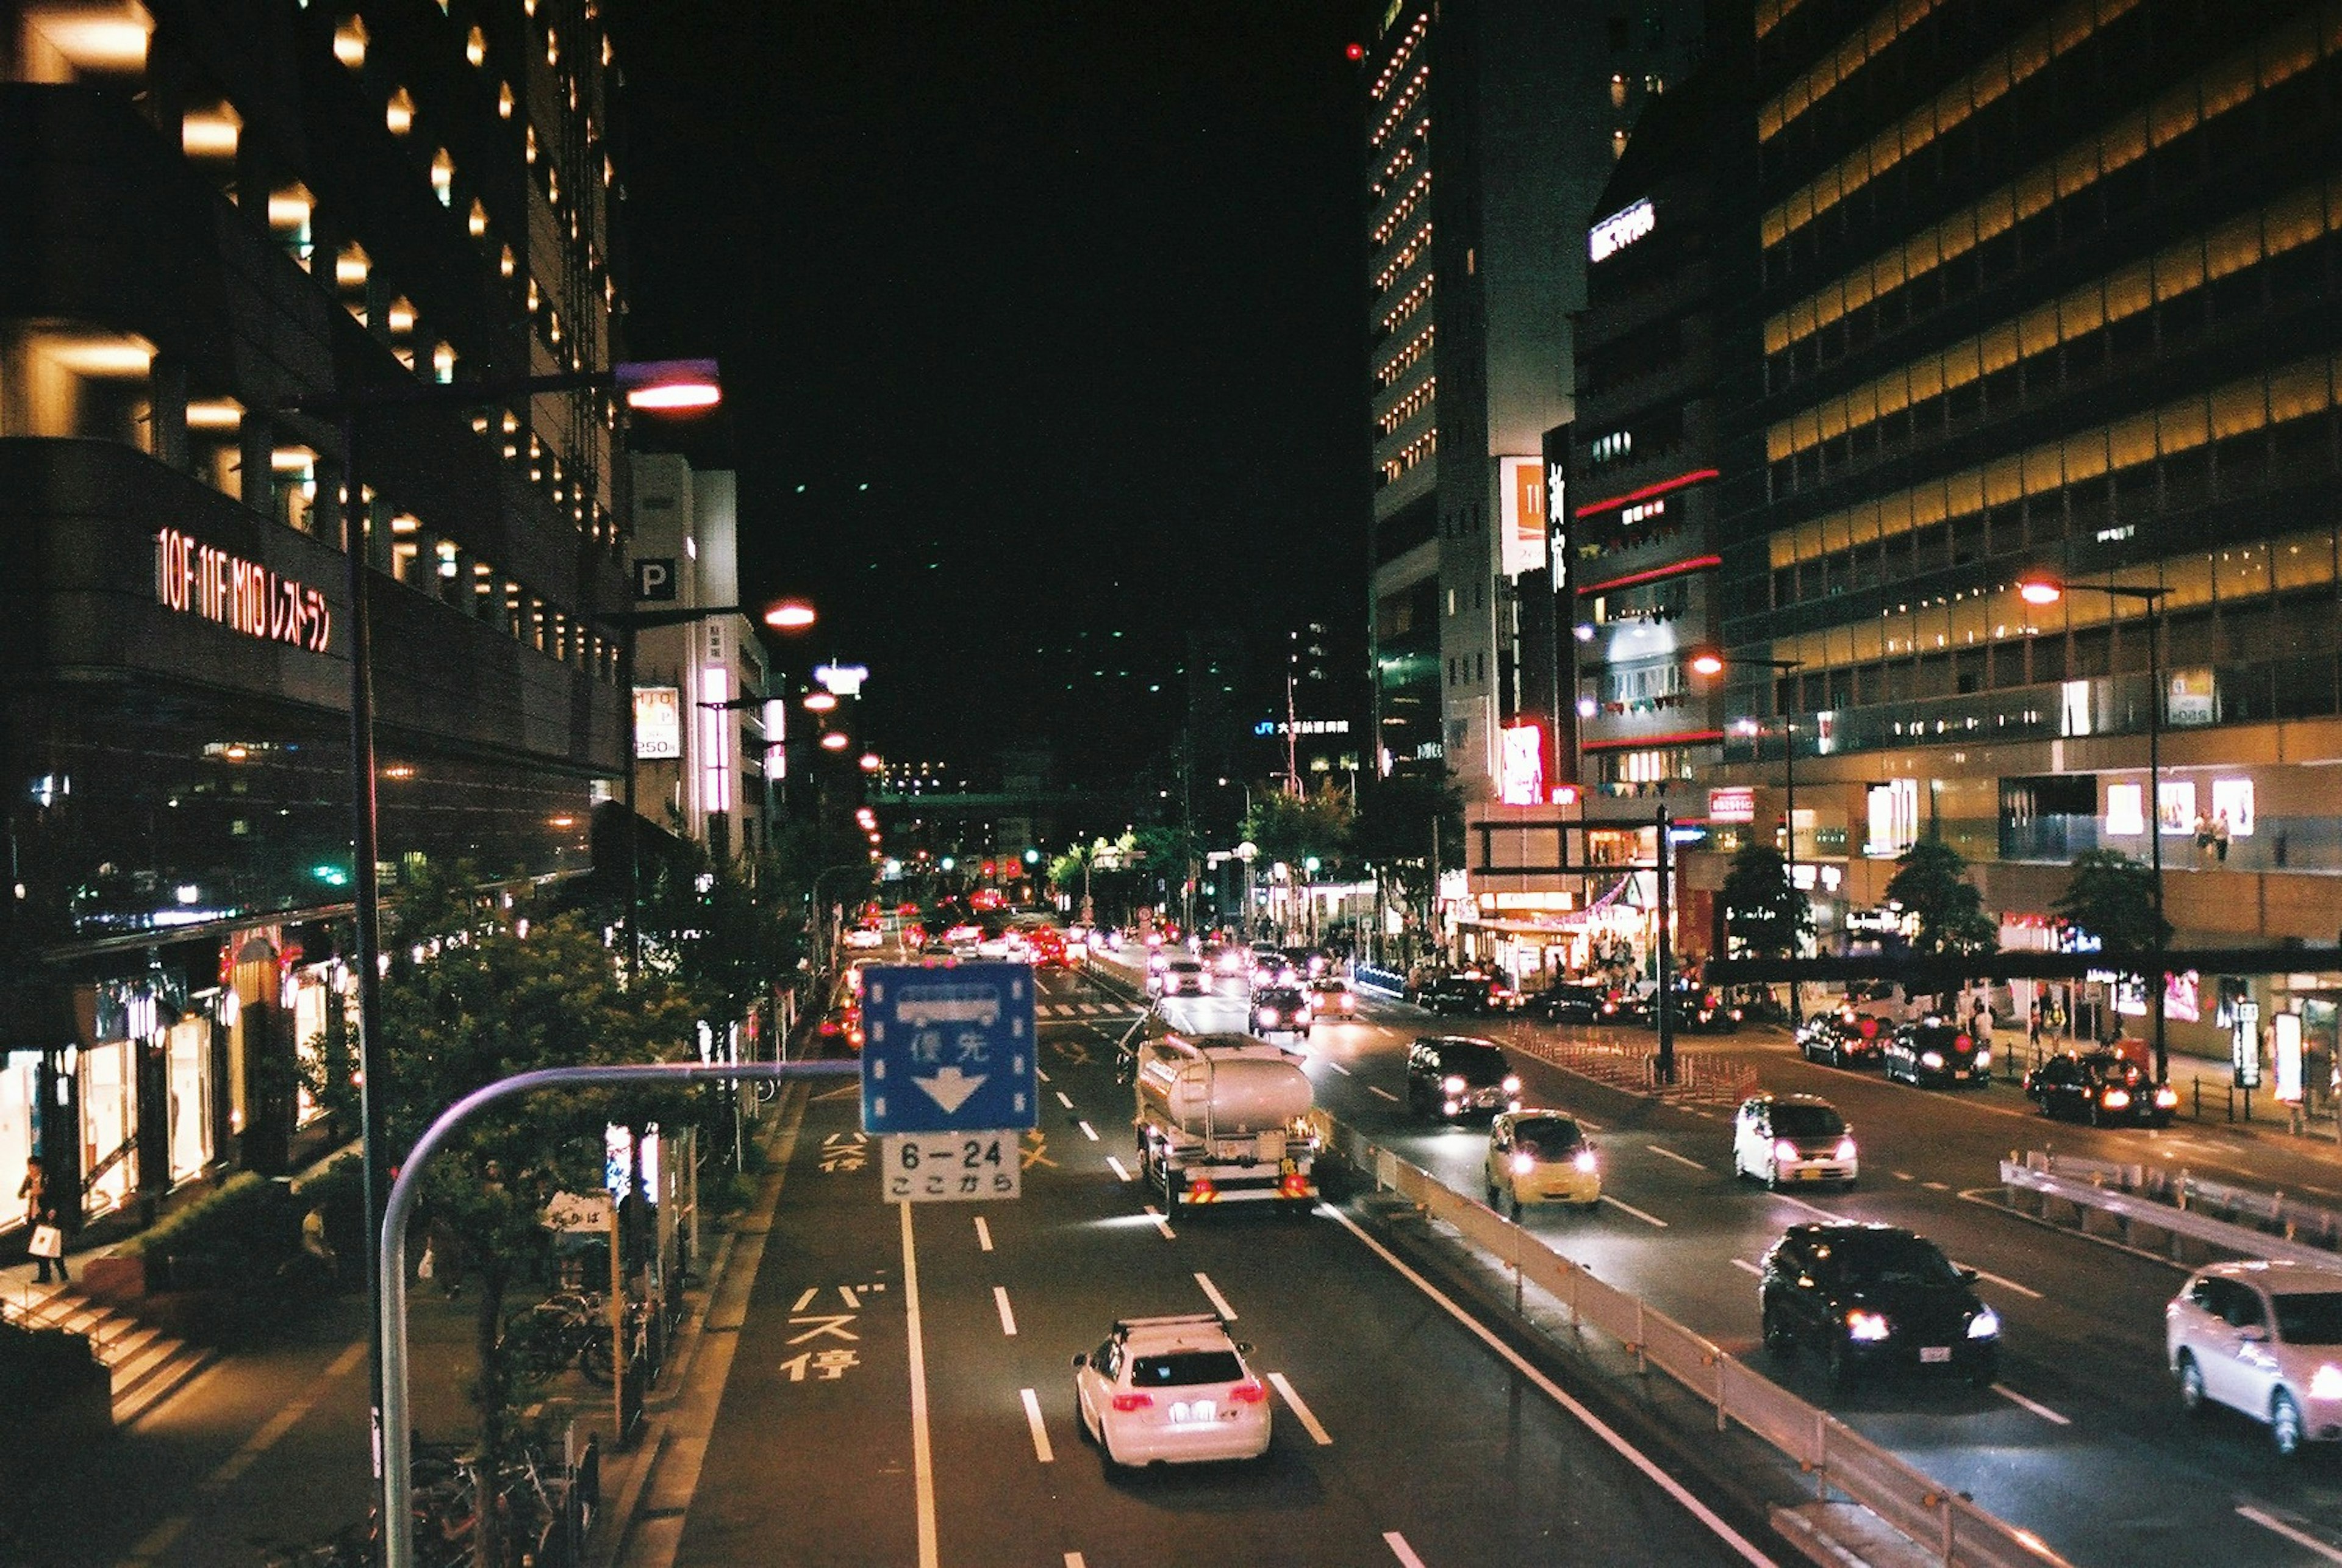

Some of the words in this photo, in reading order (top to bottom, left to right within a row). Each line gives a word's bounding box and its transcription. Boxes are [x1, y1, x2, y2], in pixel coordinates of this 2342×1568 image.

[231, 556, 267, 639] MIO
[270, 571, 330, 653] レストラン
[642, 564, 667, 595] P
[892, 1173, 1012, 1196] ここから
[779, 1283, 886, 1383] バス停
